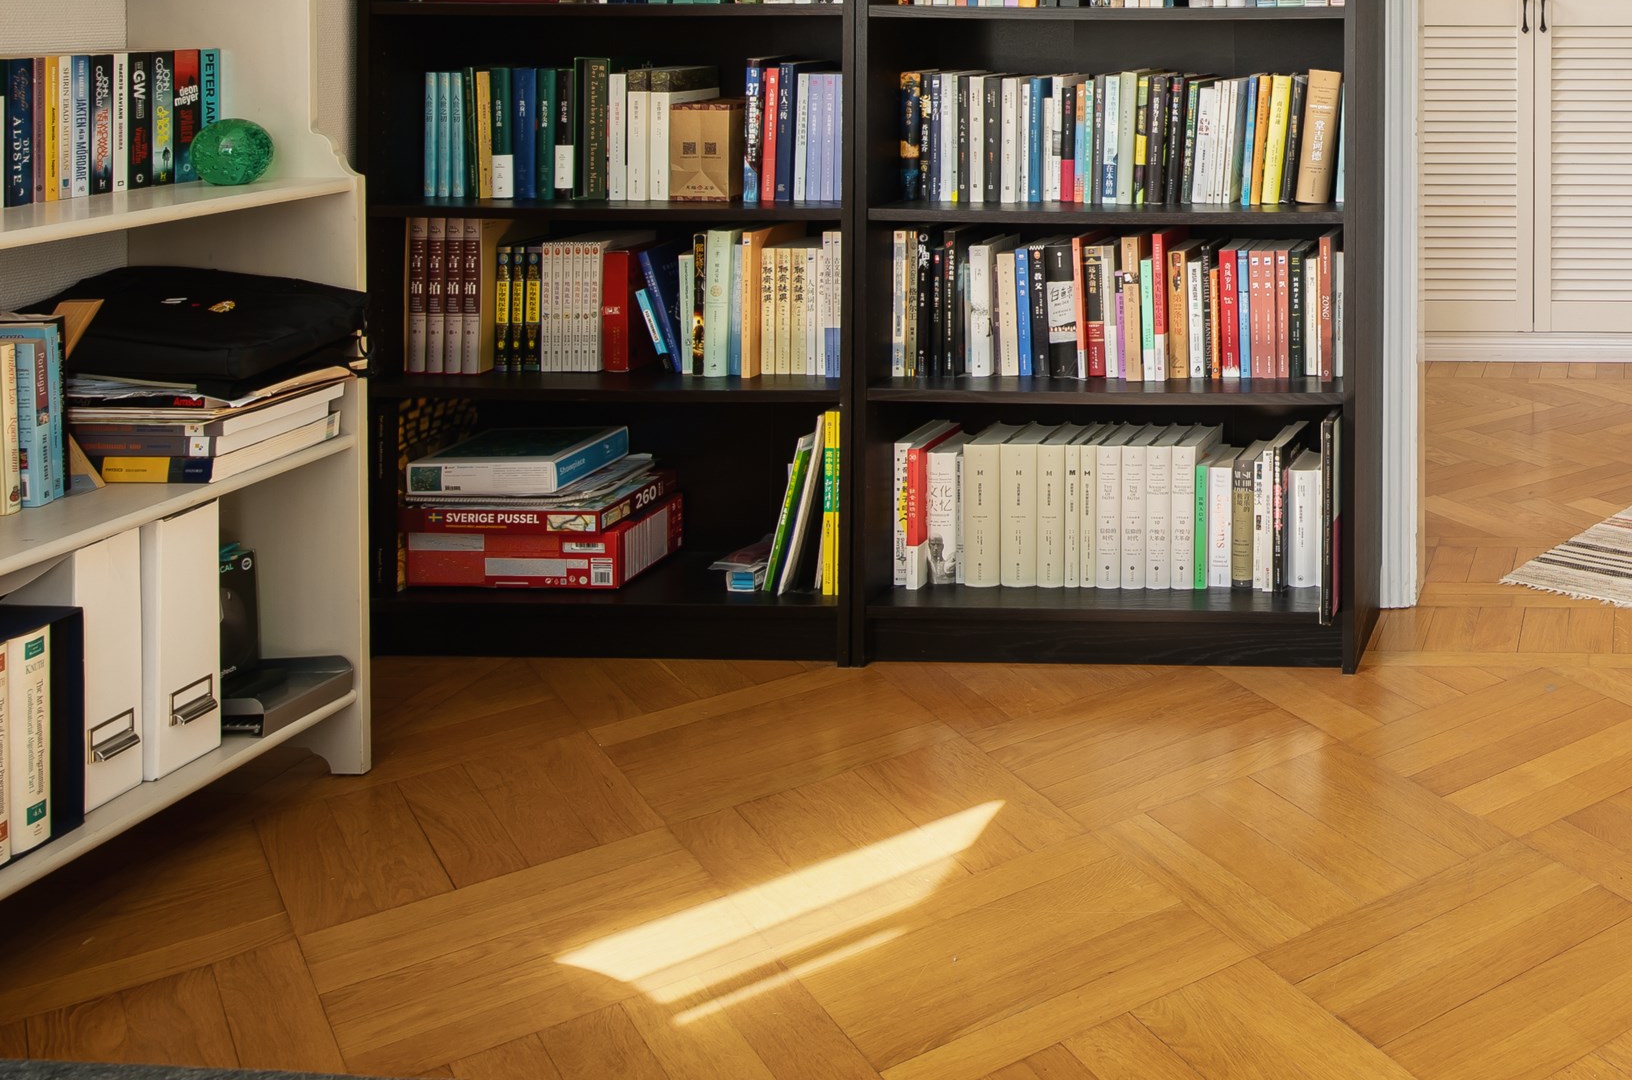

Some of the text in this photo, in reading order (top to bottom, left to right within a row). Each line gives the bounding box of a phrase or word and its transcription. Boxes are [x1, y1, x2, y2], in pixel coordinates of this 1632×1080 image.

[134, 70, 146, 100] GW
[205, 53, 215, 98] PETER
[174, 94, 198, 106] meyer
[179, 85, 198, 97] deon
[746, 83, 759, 95] 37
[76, 98, 86, 128] JAKTEN
[96, 113, 103, 121] IN
[780, 89, 788, 120] 巨人三传
[13, 116, 25, 186] ÄLDSTE
[76, 142, 88, 181] MÖRDARE
[1034, 273, 1043, 290] 教父
[1224, 262, 1232, 291] 奇风岁月
[1322, 295, 1330, 320] ZONG!
[8, 348, 16, 384] Umberto
[37, 352, 46, 396] Portugal
[173, 398, 203, 407] Amsco
[634, 485, 658, 510] 260
[931, 485, 952, 498] 文化
[929, 499, 952, 512] 失忆
[445, 513, 540, 524] SVERIGE PUSSEL
[25, 659, 44, 675] KNUTH
[36, 679, 44, 693] The
[26, 688, 34, 735] Combinatorial
[37, 695, 45, 705] Art
[35, 714, 44, 748] Computer
[35, 749, 45, 794] Programming
